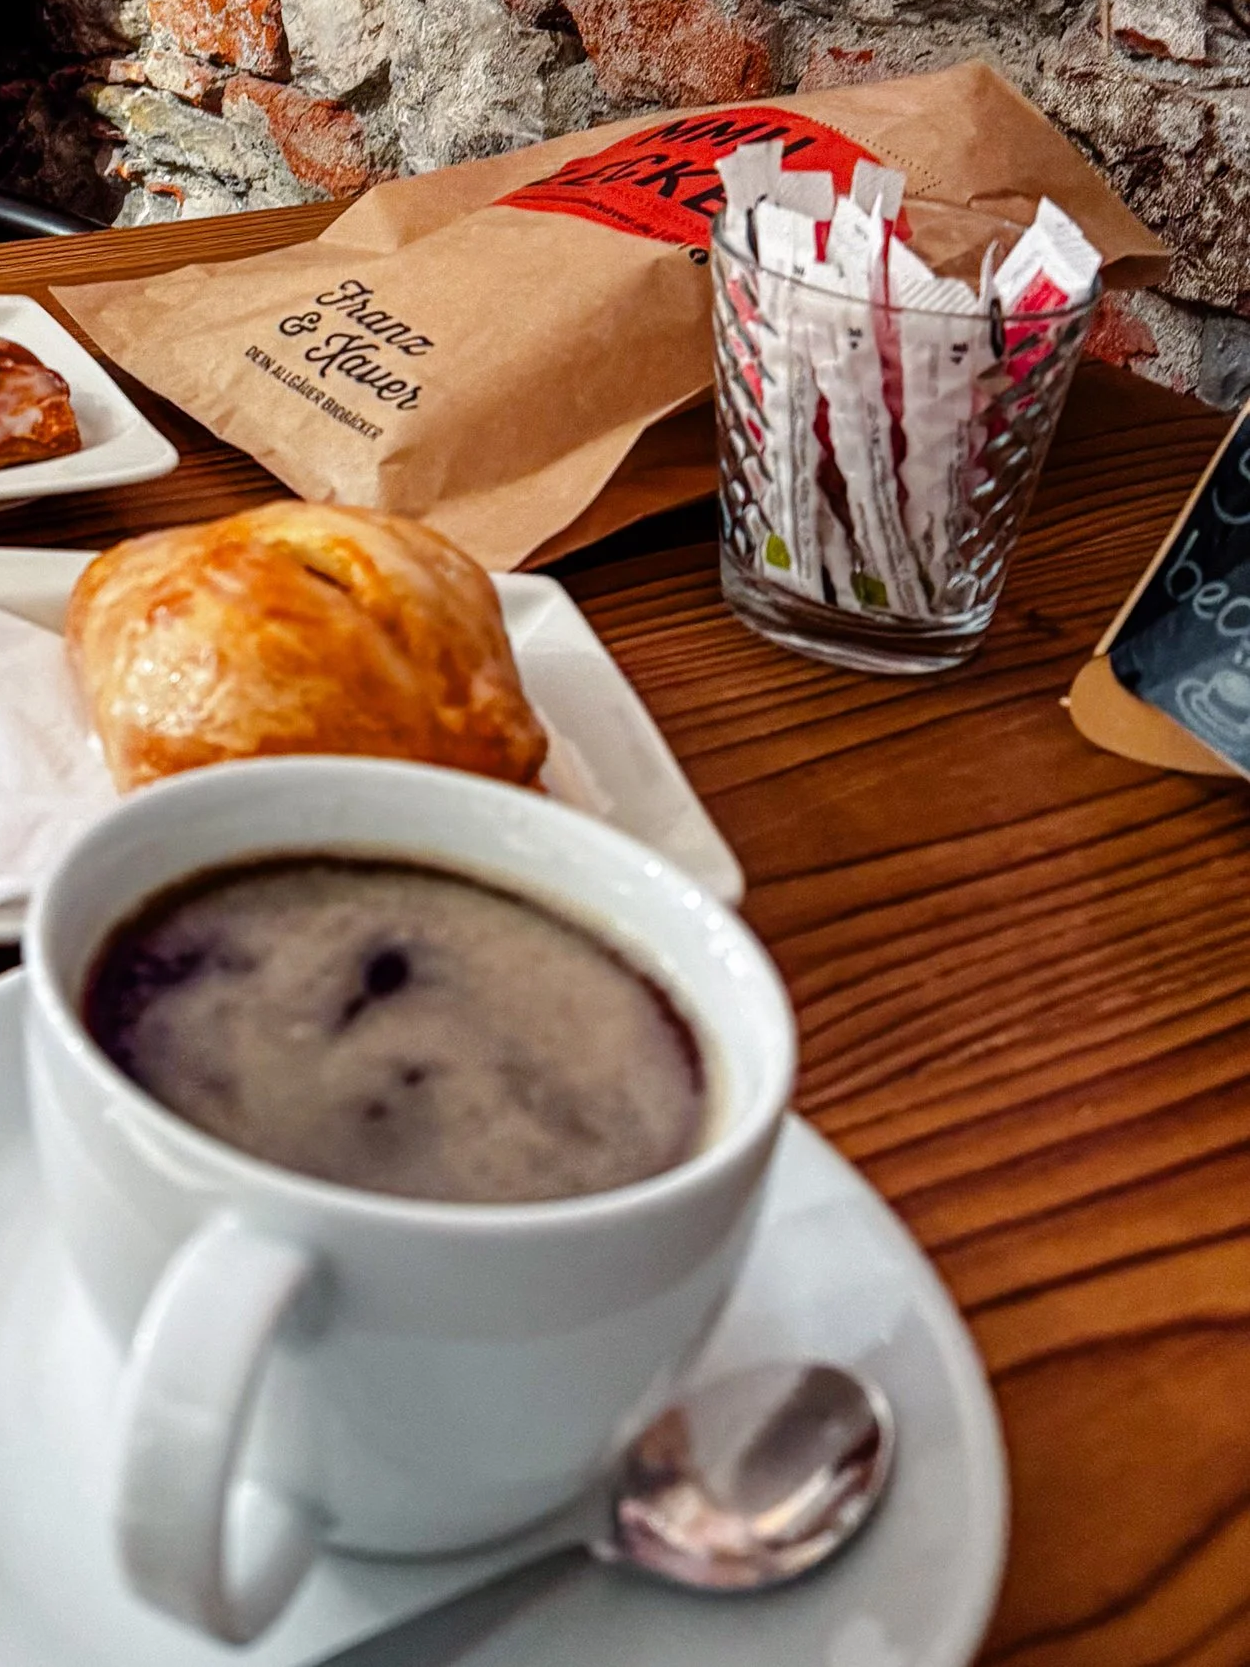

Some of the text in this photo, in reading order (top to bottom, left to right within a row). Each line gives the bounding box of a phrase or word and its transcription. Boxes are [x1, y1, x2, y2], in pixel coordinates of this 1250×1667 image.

[316, 279, 435, 357] Franz
[244, 345, 277, 373] DEIN
[279, 311, 423, 411] & Xaver
